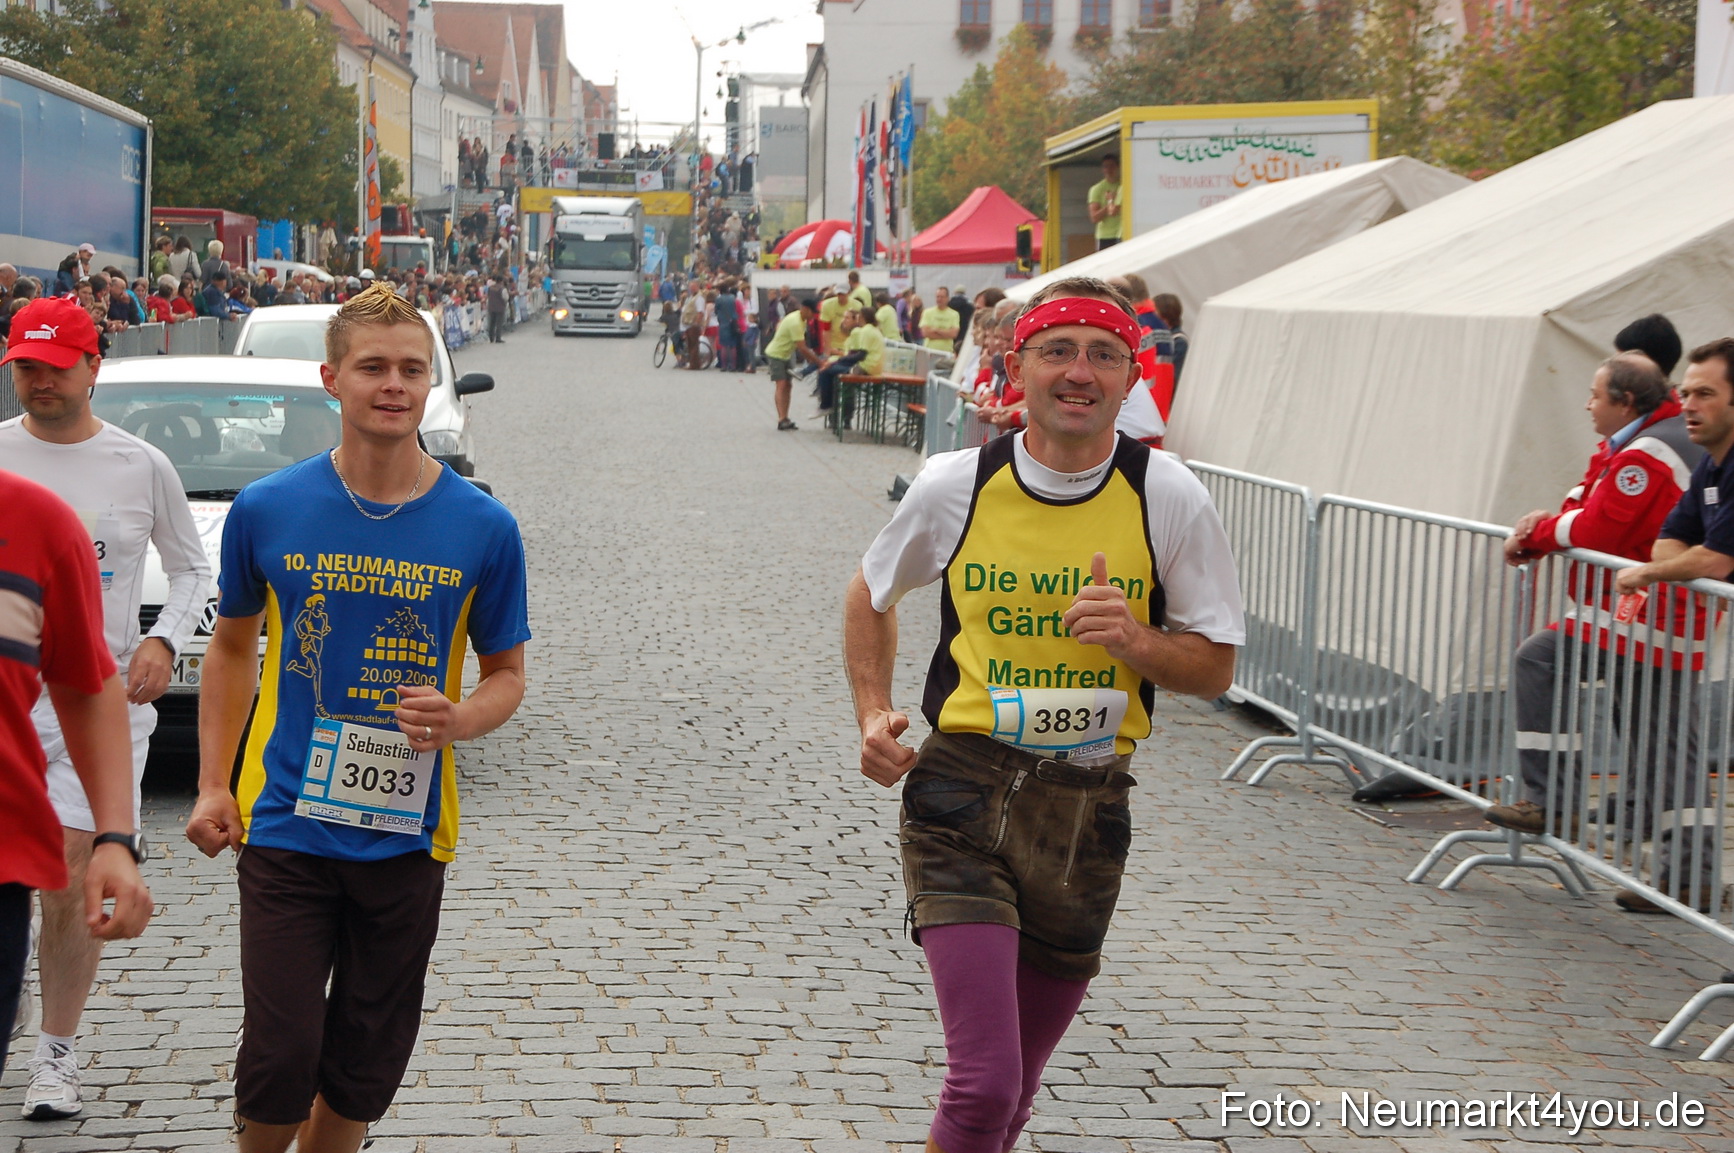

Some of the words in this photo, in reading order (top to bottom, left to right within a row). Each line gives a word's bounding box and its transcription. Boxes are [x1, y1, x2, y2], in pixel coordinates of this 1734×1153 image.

[283, 553, 311, 571] 10.
[317, 553, 463, 588] NEUMARKTER
[965, 562, 1018, 593] Die
[311, 572, 434, 602] STADTLAUF
[360, 667, 438, 687] 20.09.2009
[987, 658, 1117, 689] Manfred
[332, 714, 399, 725] www.stadtlauf-n
[1033, 706, 1108, 734] 3831
[314, 754, 324, 768] D
[346, 732, 419, 762] Sebastian
[1069, 739, 1114, 757] PFLEIDERER
[341, 762, 416, 797] 3033
[374, 814, 421, 828] PFLEIDERER
